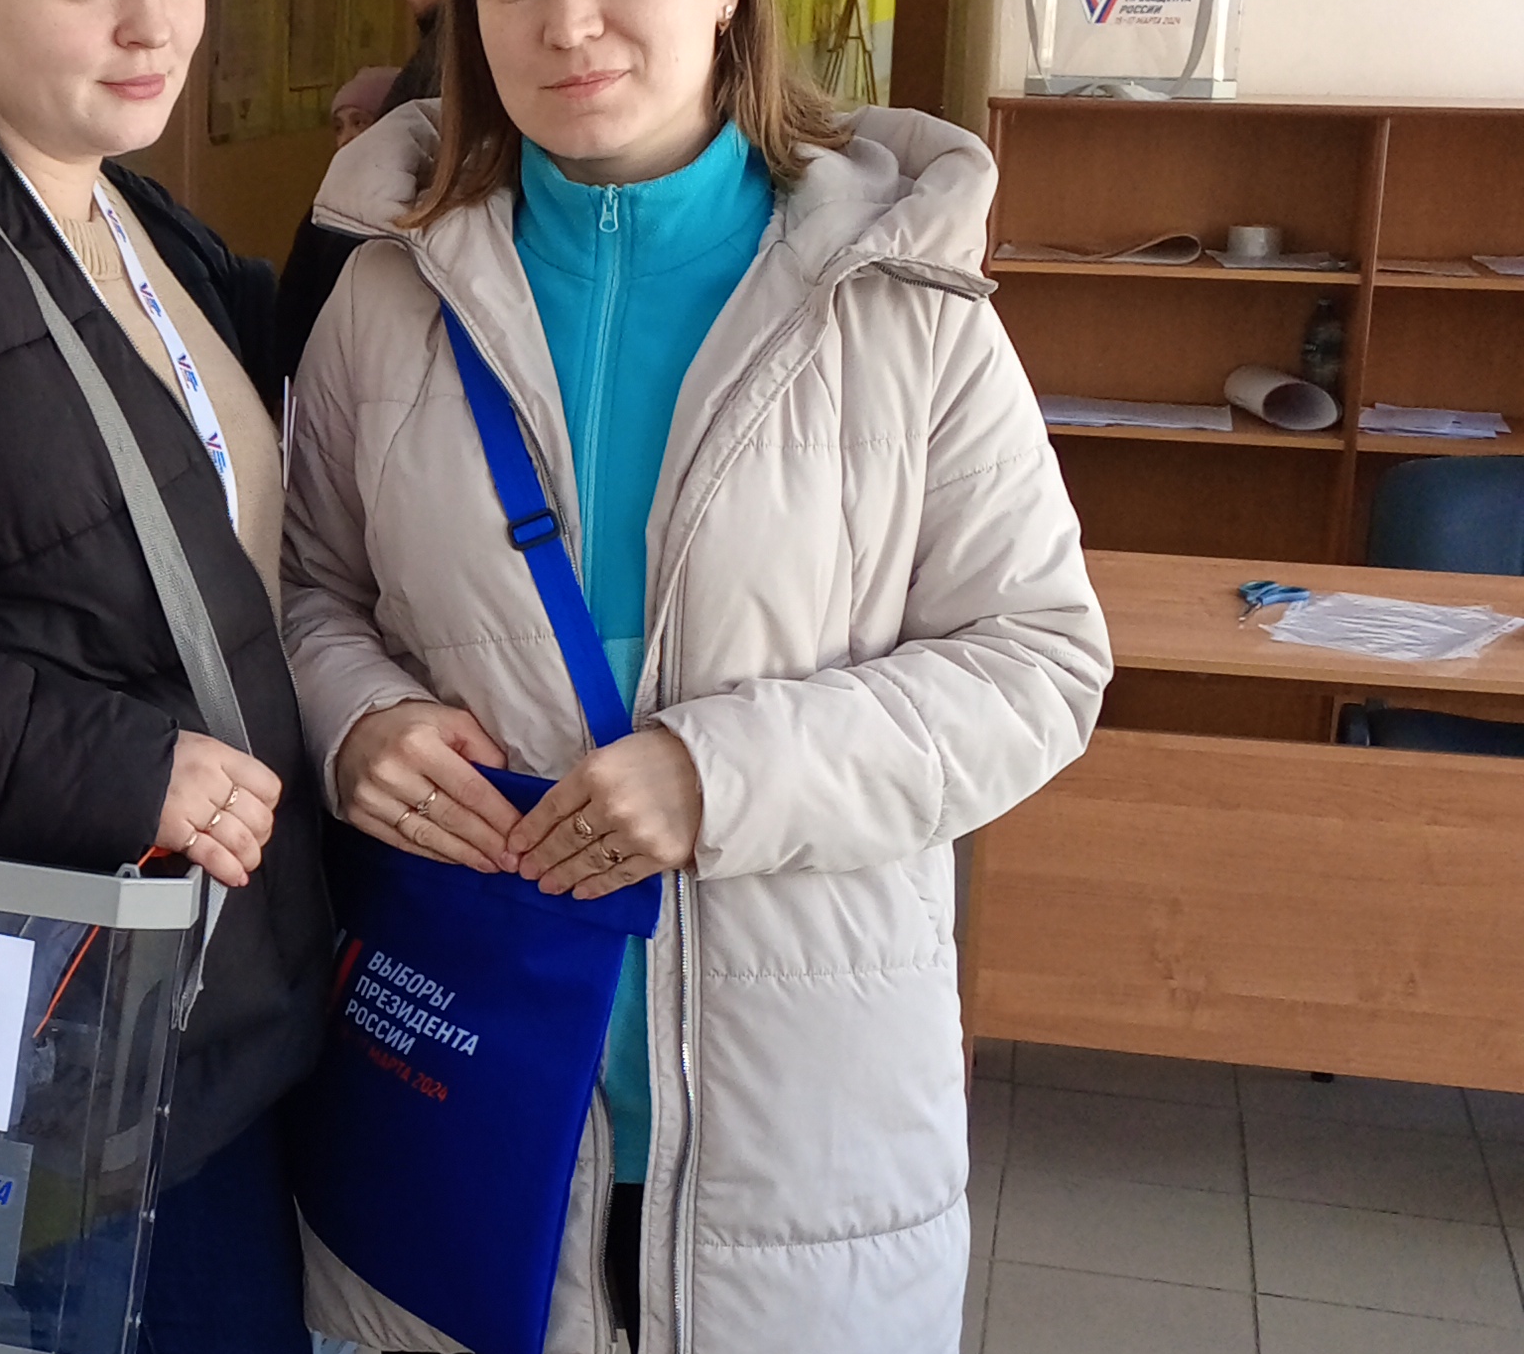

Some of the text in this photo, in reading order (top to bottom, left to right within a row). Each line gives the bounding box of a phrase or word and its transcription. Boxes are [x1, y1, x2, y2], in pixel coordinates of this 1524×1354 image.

[1118, 5, 1163, 14] РОССИИ
[367, 950, 456, 1011] ВЫБОРЫ
[344, 998, 416, 1056] РОССИИ
[355, 975, 480, 1057] ПРЕЗИДЕНТА
[368, 1045, 449, 1103] МАРТА 2024
